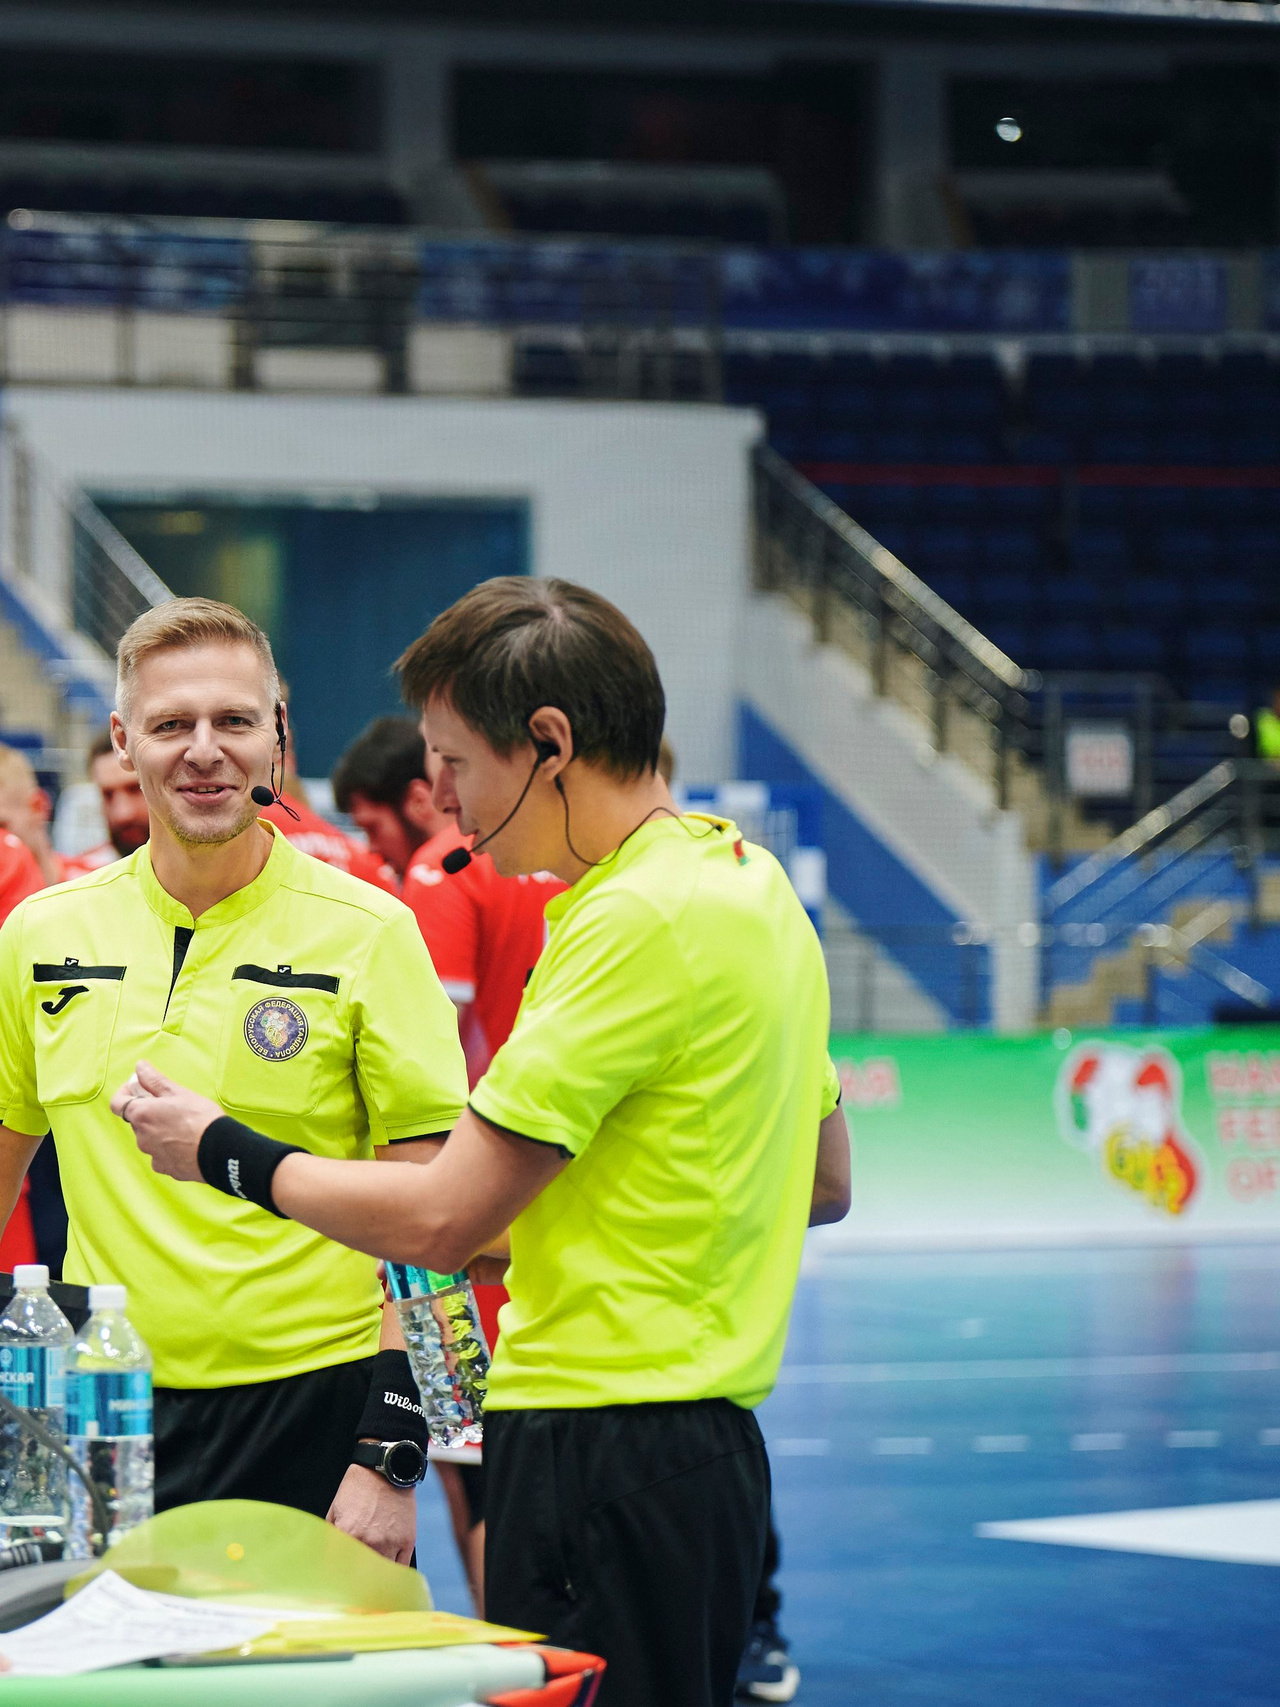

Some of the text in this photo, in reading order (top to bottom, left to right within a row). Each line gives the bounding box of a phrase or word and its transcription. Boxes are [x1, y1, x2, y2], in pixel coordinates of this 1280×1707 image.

[264, 1000, 304, 1026] ФЕДЕРАЦИЯ
[247, 1005, 269, 1056] БЕЛОРУССКАЯ
[274, 1027, 305, 1058] ГАНДБОЛА
[383, 1391, 425, 1418] Wilson
